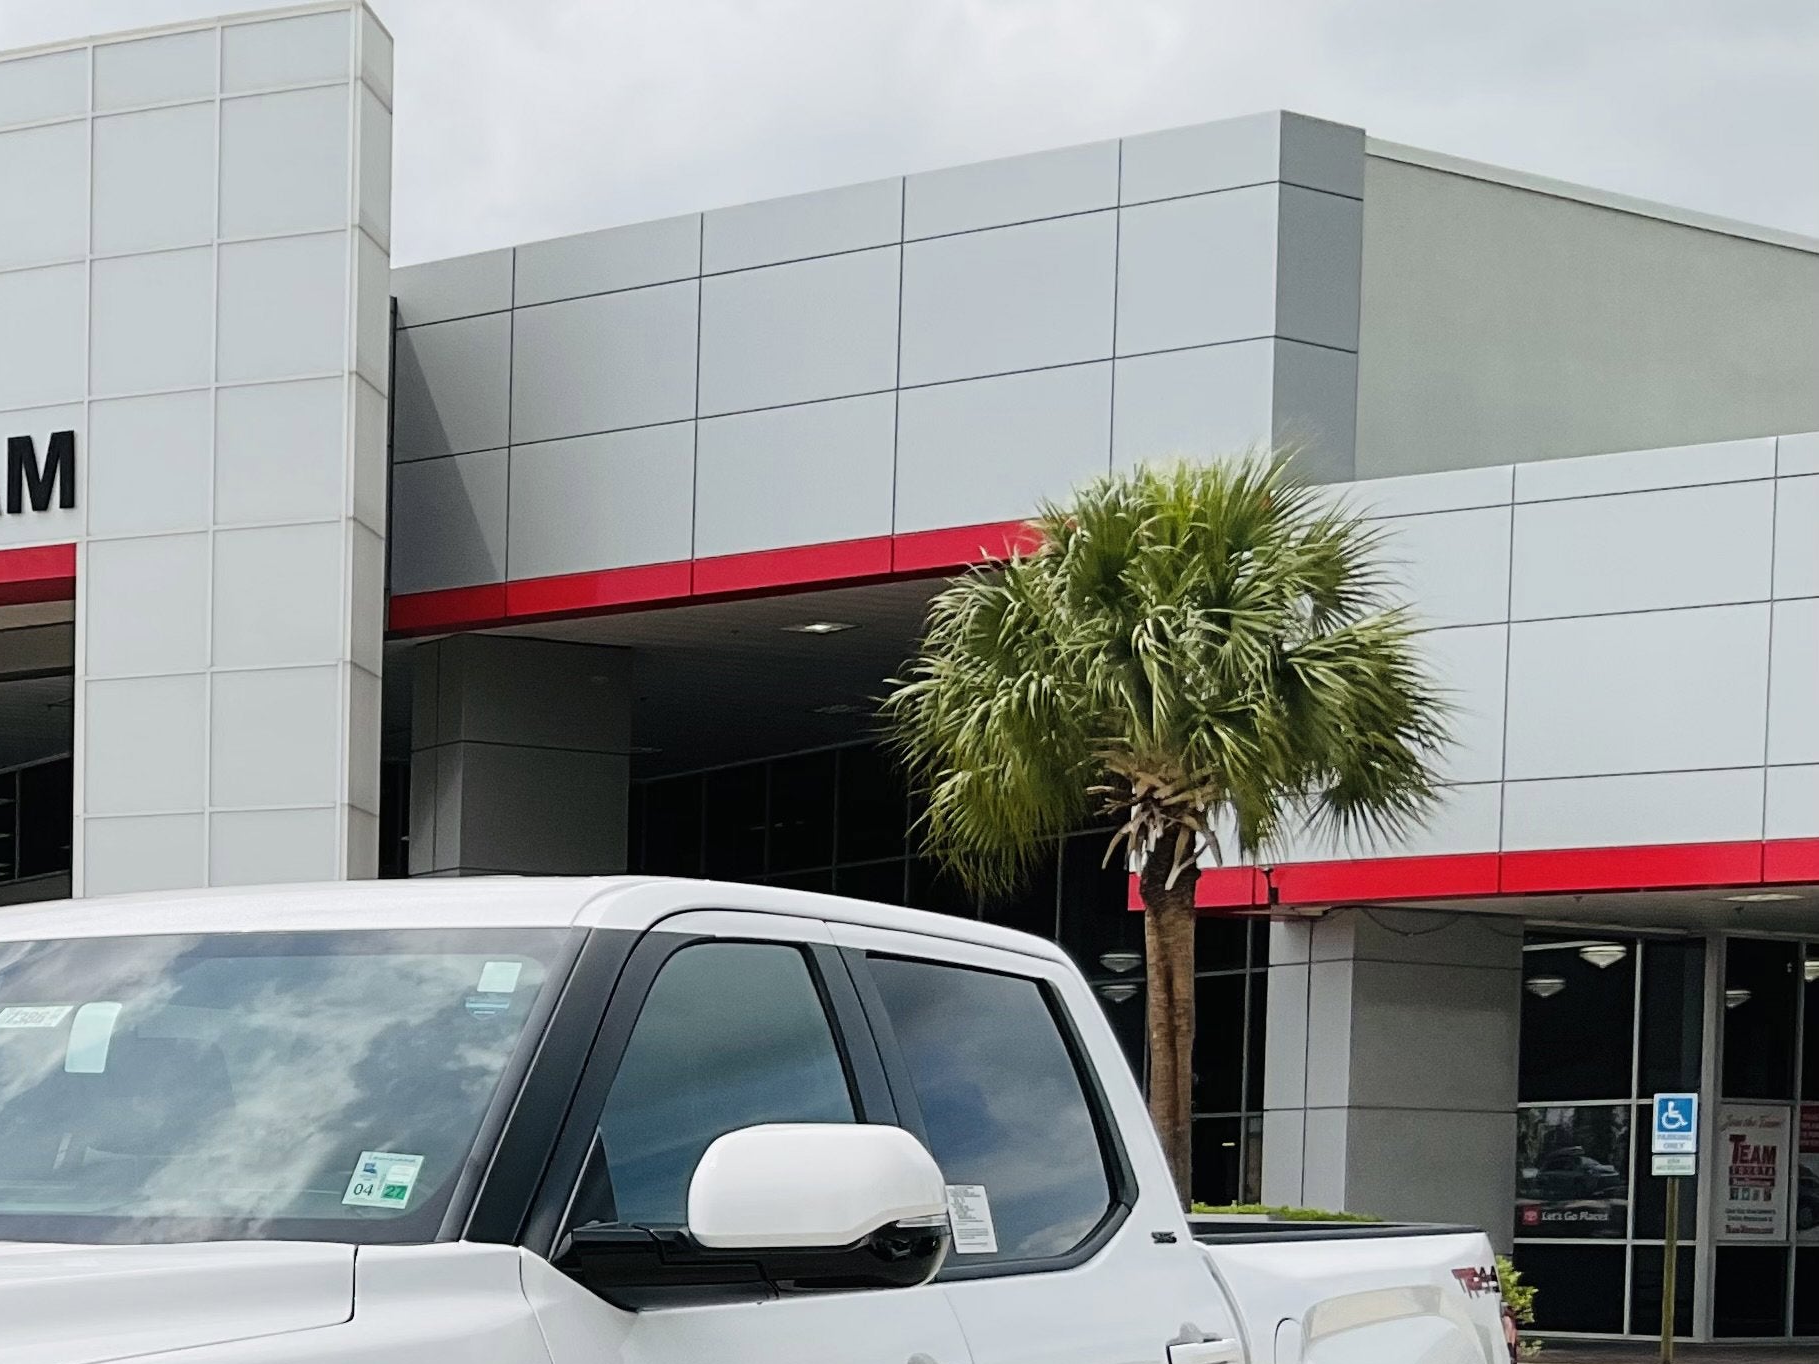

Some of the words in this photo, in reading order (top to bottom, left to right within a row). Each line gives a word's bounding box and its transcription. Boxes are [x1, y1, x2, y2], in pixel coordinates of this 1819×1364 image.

[353, 1183, 374, 1196] 04
[384, 1185, 408, 1200] 27
[1564, 1211, 1578, 1221] Go
